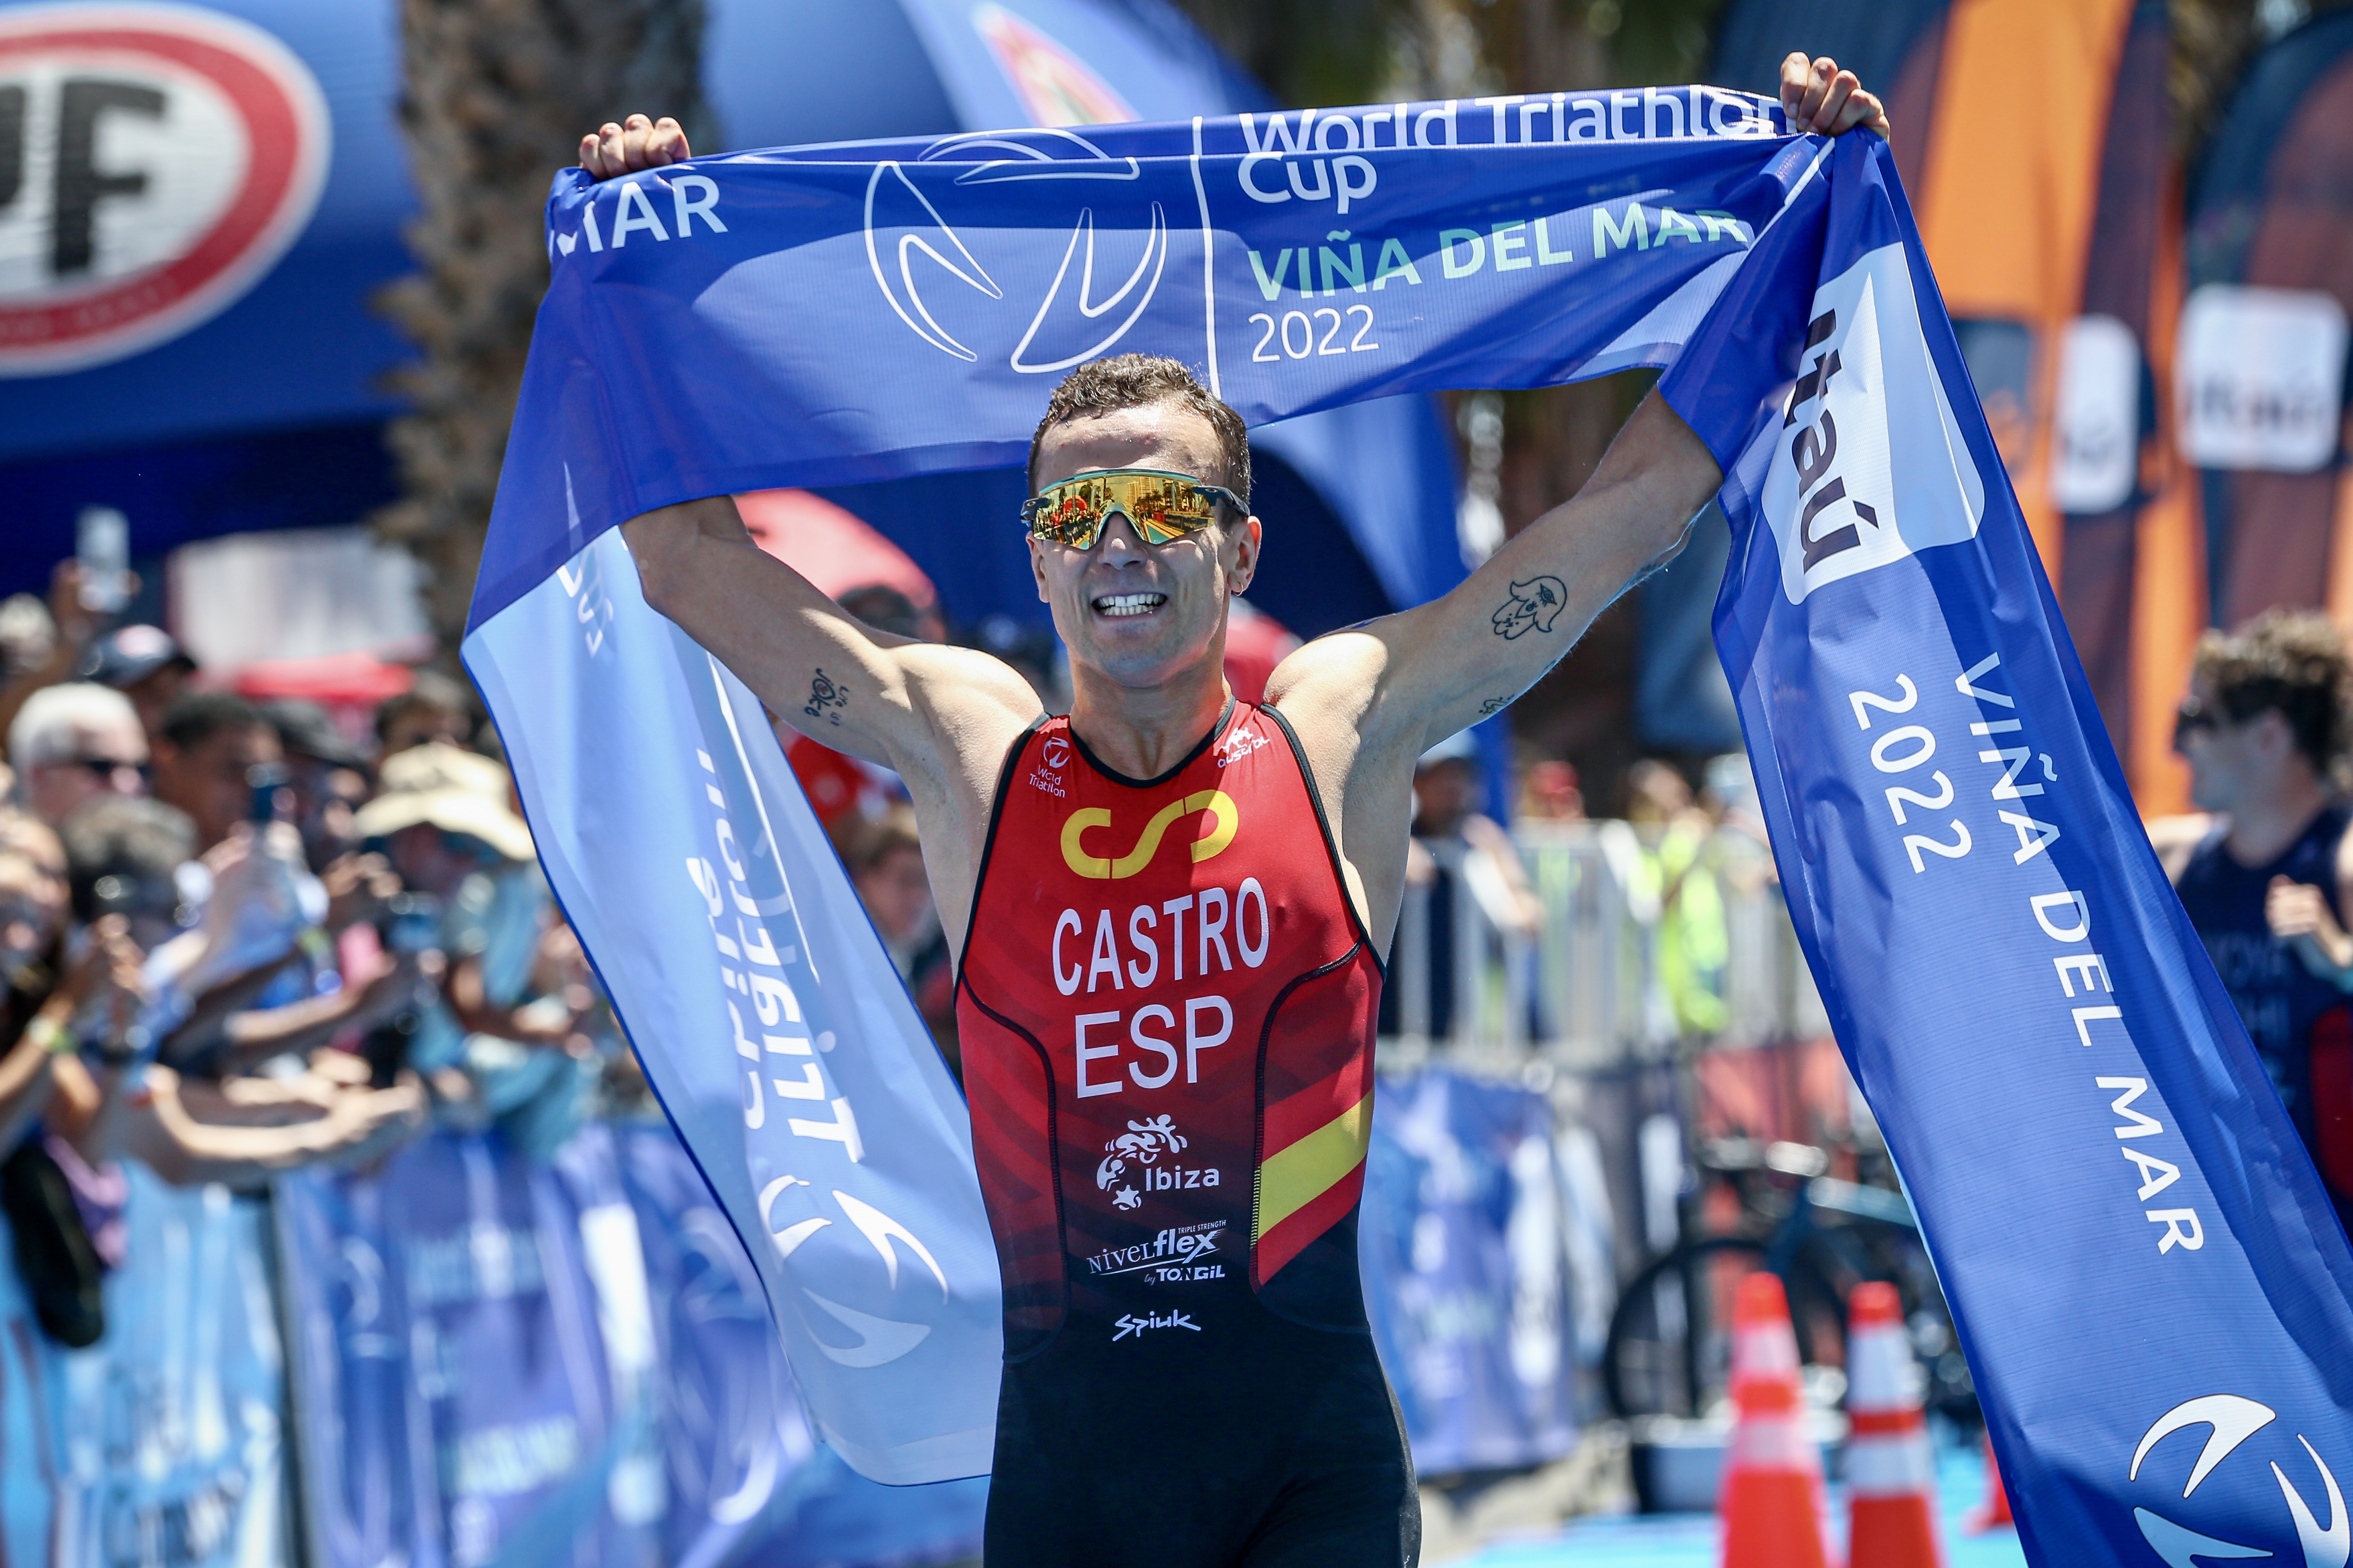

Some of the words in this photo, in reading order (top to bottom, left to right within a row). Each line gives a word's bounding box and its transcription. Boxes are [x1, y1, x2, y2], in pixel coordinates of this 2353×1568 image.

[1239, 100, 1458, 153] World
[1237, 150, 1377, 214] Cup
[1247, 229, 1422, 302] VIÑA
[1439, 217, 1573, 279] DEL
[1592, 202, 1748, 260] MAR
[1248, 304, 1380, 363] 2022
[1848, 672, 1973, 874] 2022
[1051, 877, 1270, 996] CASTRO
[1954, 651, 2061, 866] VIÑA
[2029, 890, 2124, 1047] DEL
[2095, 1076, 2205, 1256] MAR
[1075, 995, 1234, 1099] ESP
[1197, 1220, 1226, 1231] STRENGTH
[1144, 1274, 1156, 1285] by
